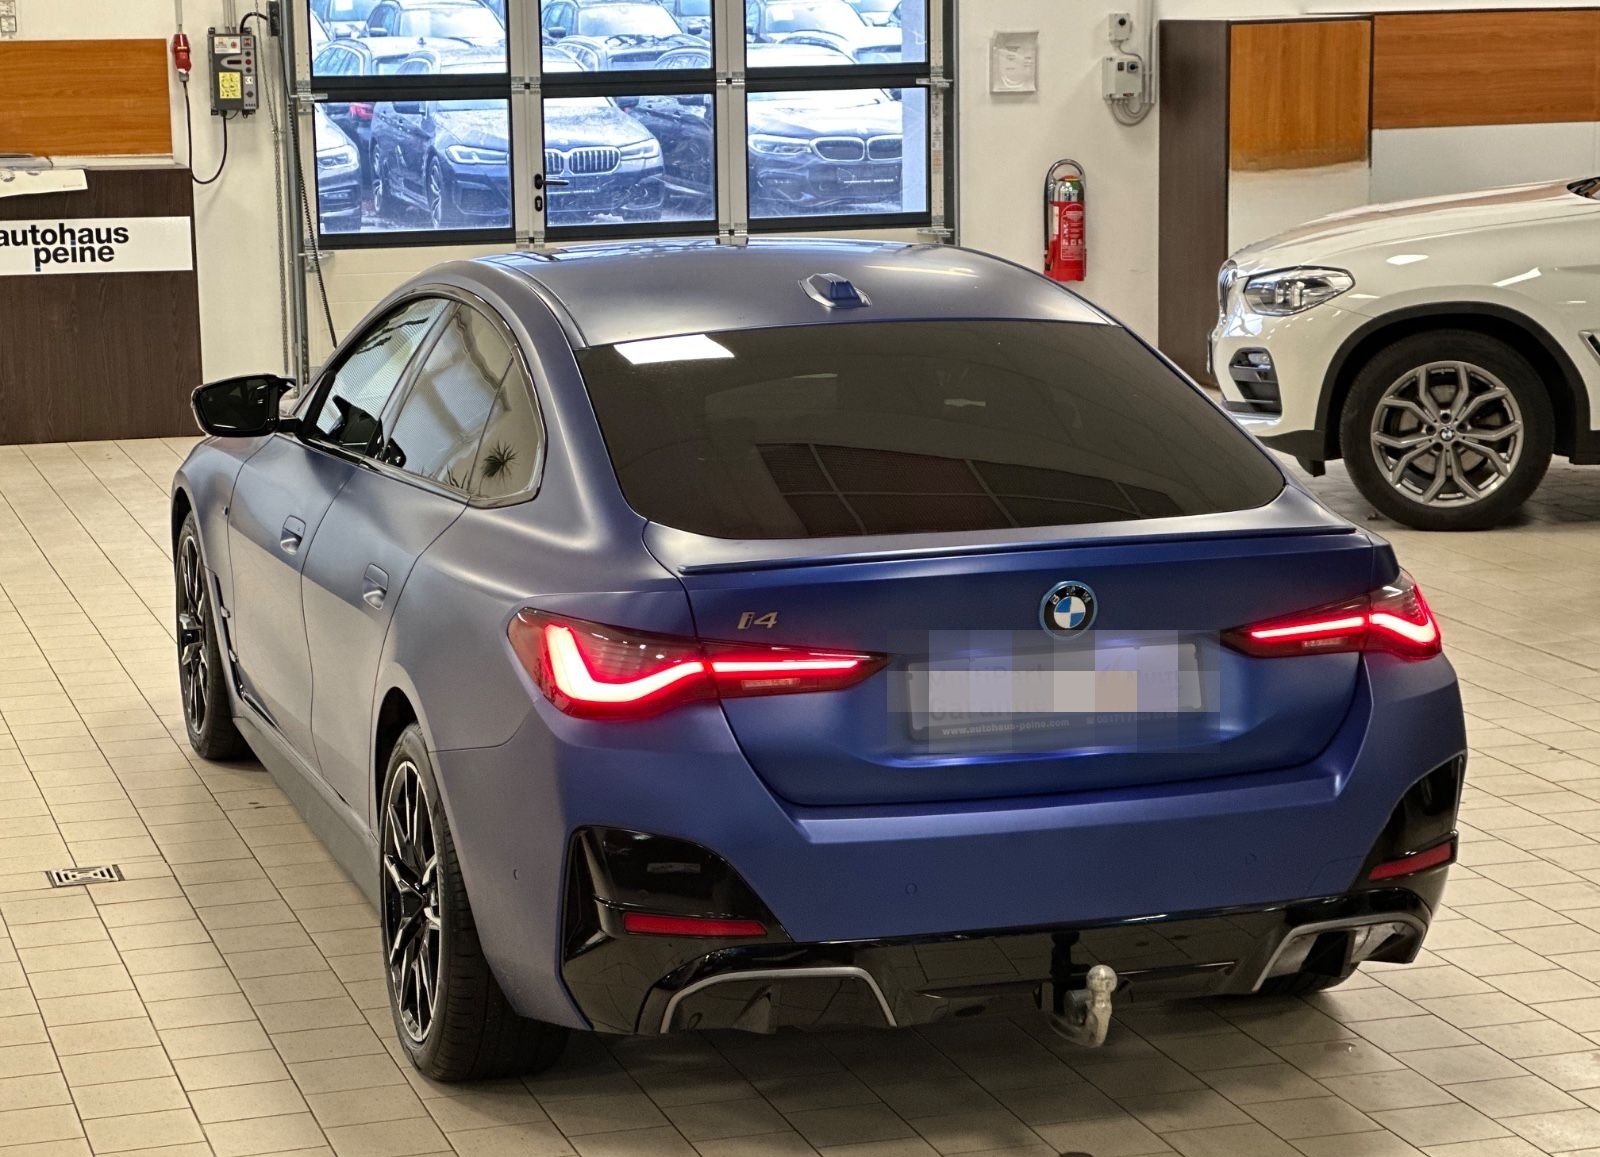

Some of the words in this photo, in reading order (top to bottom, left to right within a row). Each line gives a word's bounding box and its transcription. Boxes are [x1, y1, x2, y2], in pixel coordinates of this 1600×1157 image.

[0, 223, 129, 246] autohaus
[34, 242, 115, 272] peine
[737, 611, 778, 630] i4
